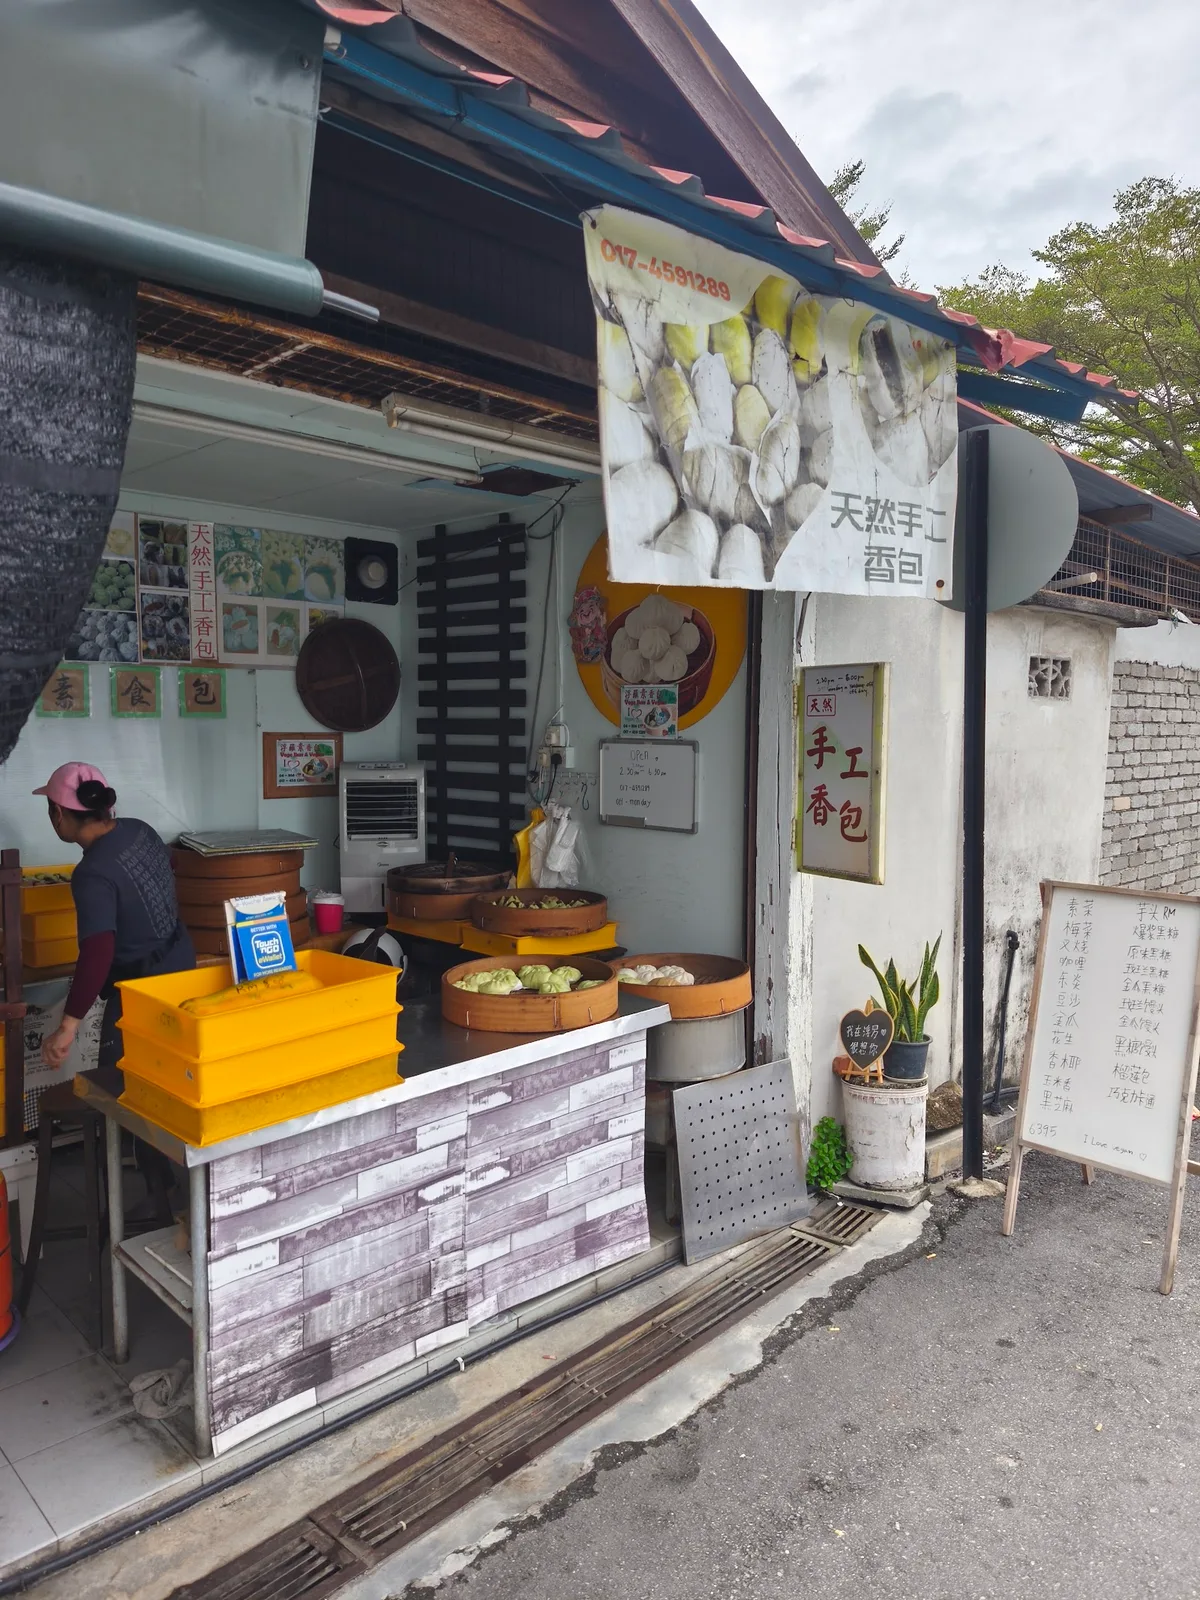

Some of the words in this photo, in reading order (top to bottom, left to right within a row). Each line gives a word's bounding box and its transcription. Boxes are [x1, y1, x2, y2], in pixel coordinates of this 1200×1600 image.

[601, 238, 731, 301] 017-4591289
[831, 490, 947, 543] 天然手工
[864, 546, 923, 584] 香包
[190, 523, 216, 660] 天然手工香包
[810, 698, 833, 713] 天然
[806, 726, 869, 779] 手工
[806, 783, 869, 843] 香包
[1067, 897, 1094, 918] 素菜
[1136, 901, 1159, 922] 芋头
[1063, 921, 1093, 940] 梅菜
[255, 937, 279, 949] Touch
[258, 953, 283, 964] eWallet
[1056, 992, 1081, 1008] 豆沙
[1051, 1011, 1080, 1028] 金瓜
[1051, 1030, 1073, 1045] 花生
[1049, 1051, 1081, 1070] 香椰
[1112, 1063, 1150, 1085] 榴莲包
[1040, 1090, 1074, 1114] 黑芝麻
[1028, 1123, 1058, 1138] 6395
[1084, 1134, 1088, 1144] I
